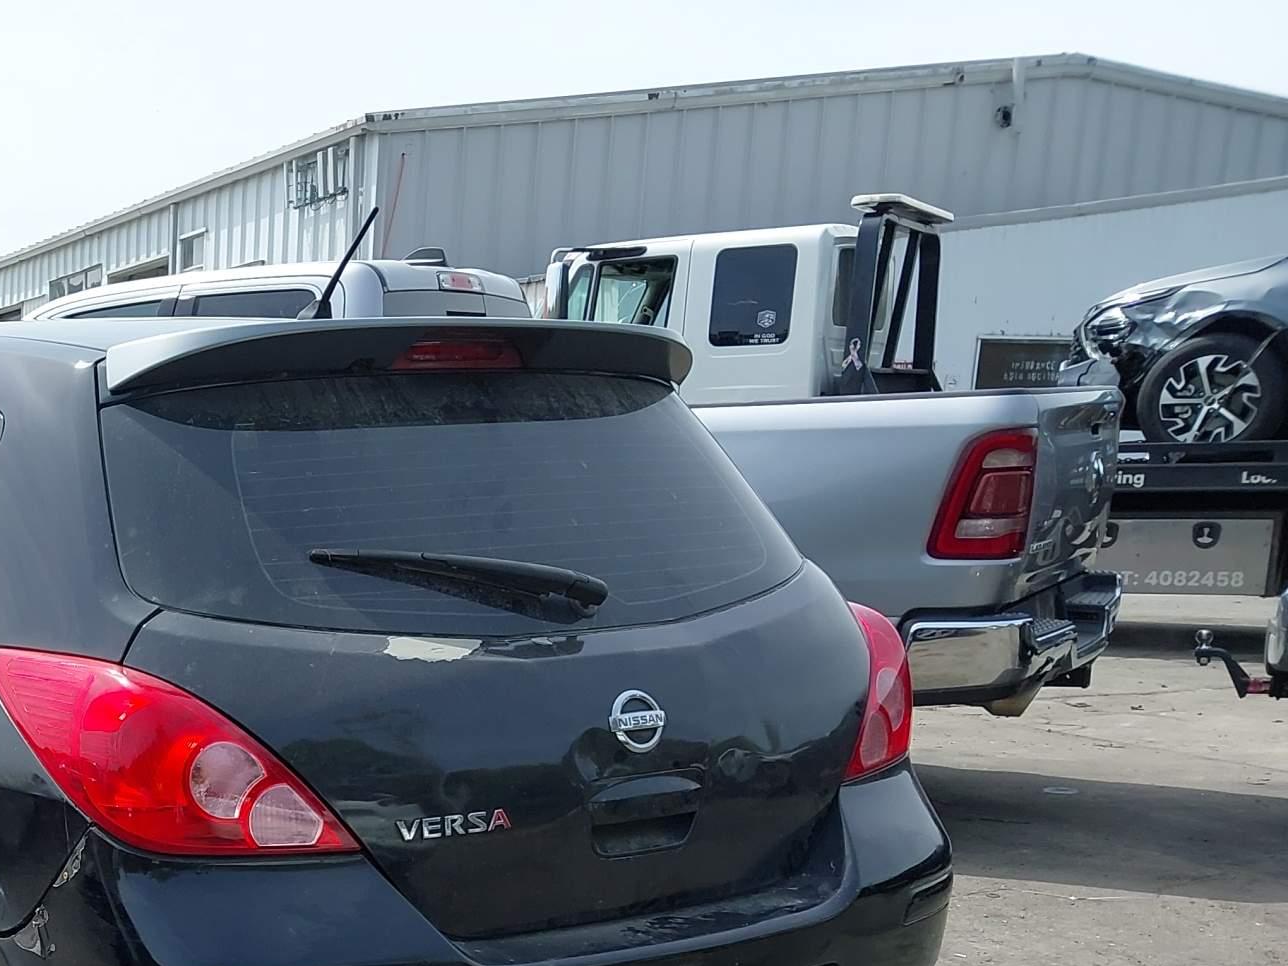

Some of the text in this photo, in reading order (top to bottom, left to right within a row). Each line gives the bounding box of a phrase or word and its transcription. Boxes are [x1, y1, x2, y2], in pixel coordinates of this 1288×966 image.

[1144, 570, 1244, 587] 4082458
[617, 713, 663, 728] NISSAN
[395, 808, 512, 841] VERSA
